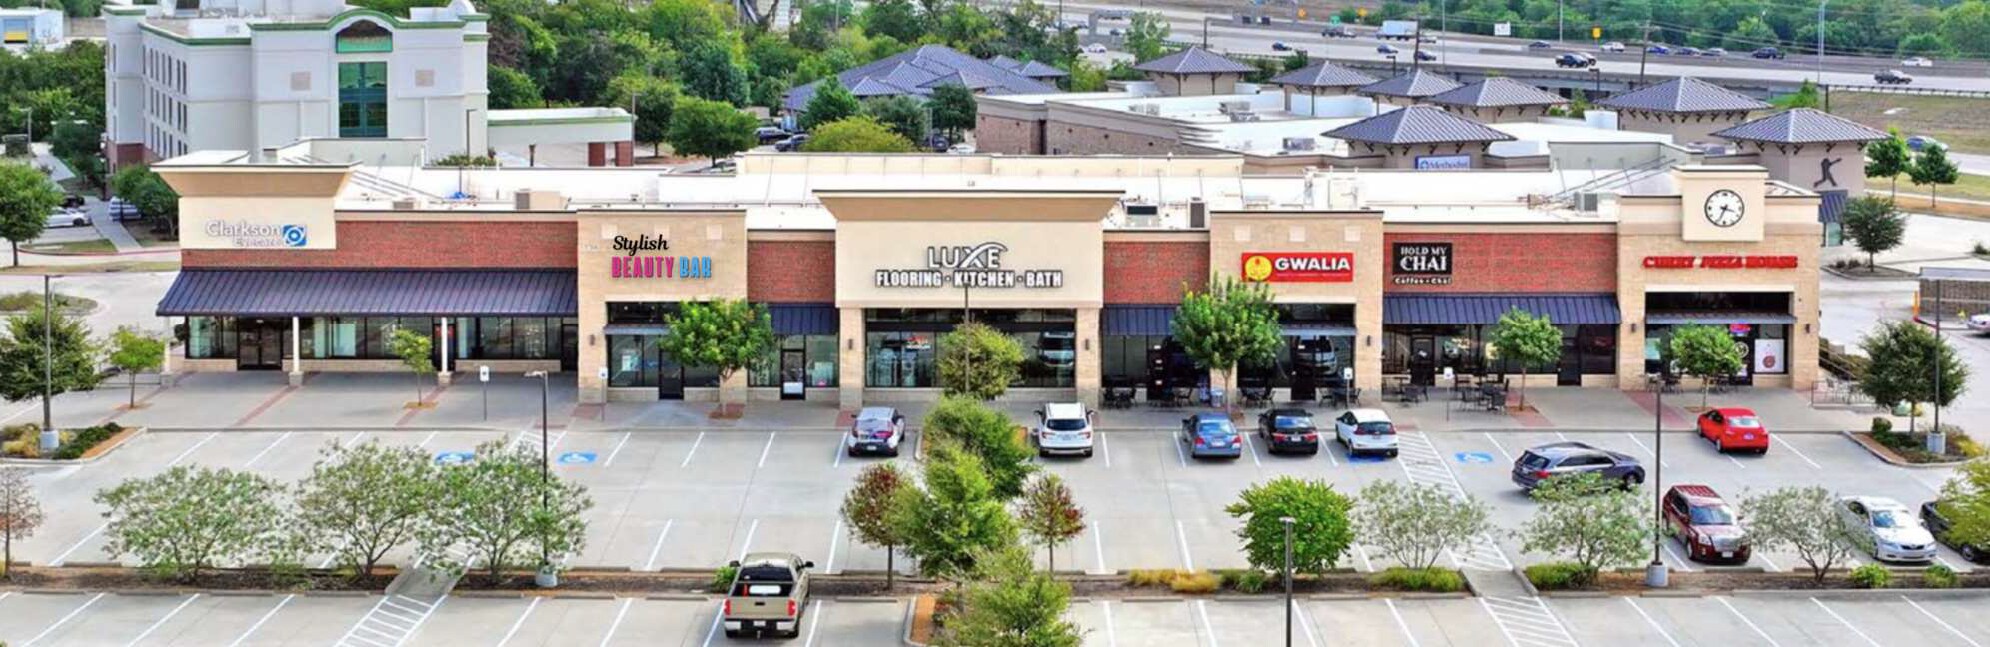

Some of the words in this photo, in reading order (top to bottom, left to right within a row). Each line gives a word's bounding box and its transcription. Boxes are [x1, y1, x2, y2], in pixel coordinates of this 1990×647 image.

[205, 219, 280, 237] Clarkson
[612, 234, 670, 256] Stylish
[1400, 246, 1429, 255] HOLD
[1431, 246, 1447, 255] MY
[927, 242, 1008, 269] LUXE
[1274, 257, 1351, 271] GWALIA
[1399, 256, 1447, 271] CHAI
[611, 256, 675, 278] BEAUTY
[679, 256, 712, 278] BAR
[875, 270, 944, 288] FLOORING
[953, 270, 1016, 288] KITCHEN
[1025, 270, 1063, 288] BATH
